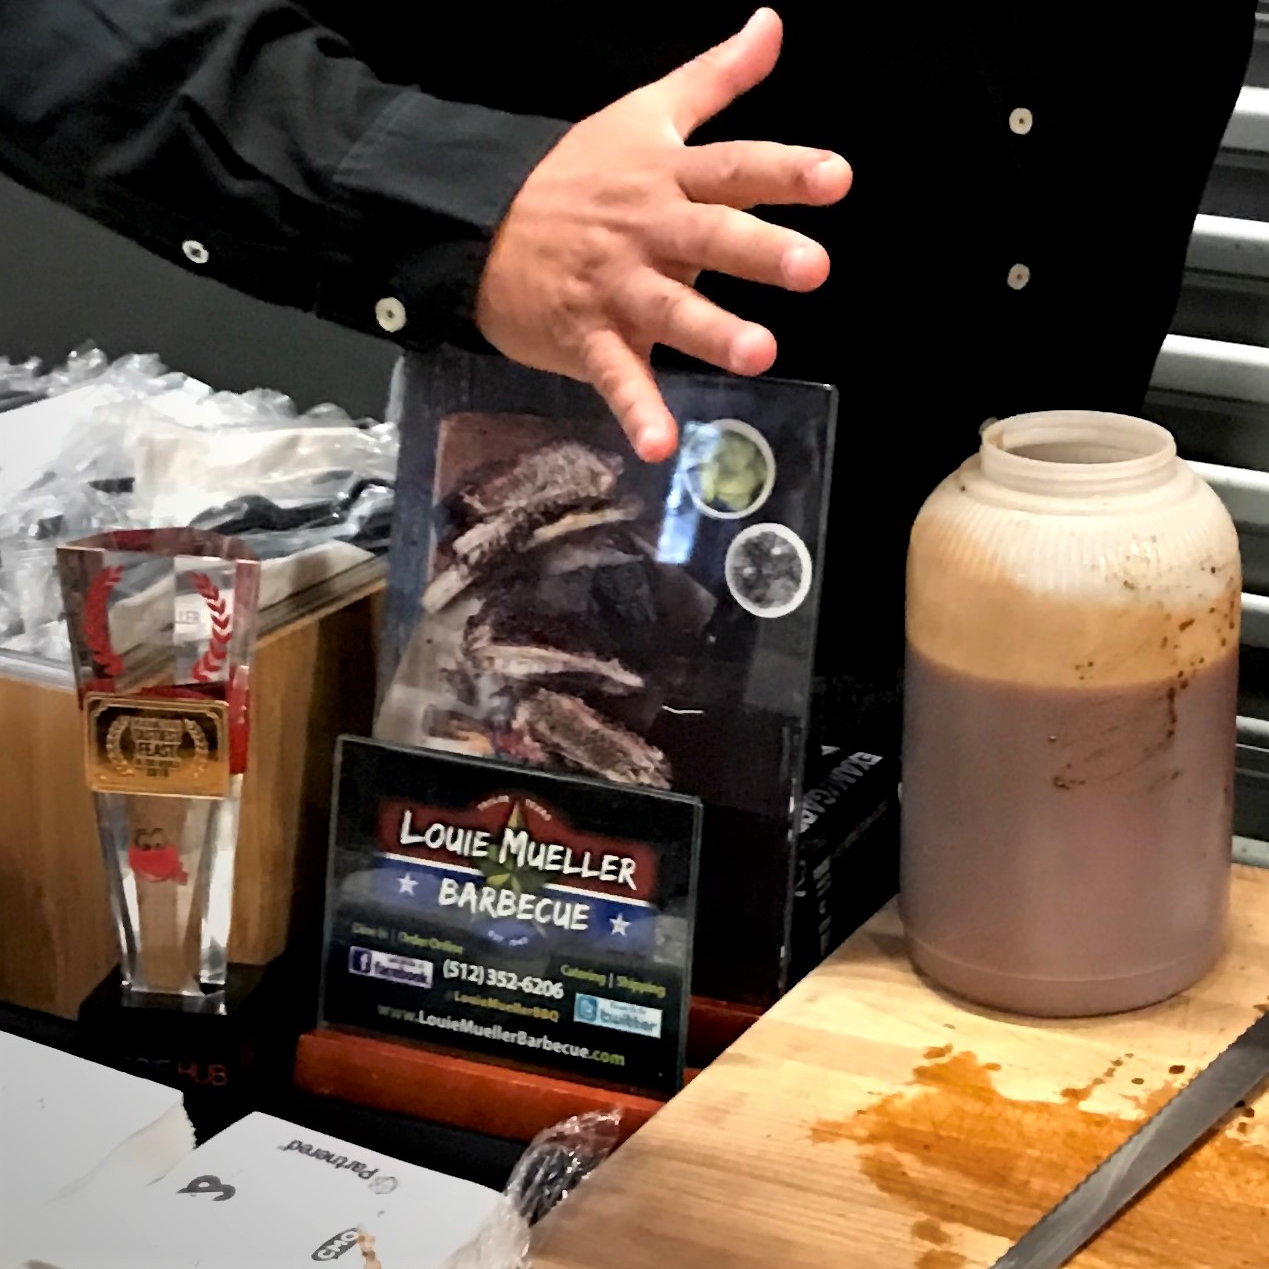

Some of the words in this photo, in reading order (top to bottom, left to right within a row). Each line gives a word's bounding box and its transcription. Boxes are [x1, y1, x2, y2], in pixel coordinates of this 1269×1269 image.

[400, 809, 491, 857] LOUIE
[498, 827, 638, 891] MUELLER
[437, 877, 591, 931] BARBECUE
